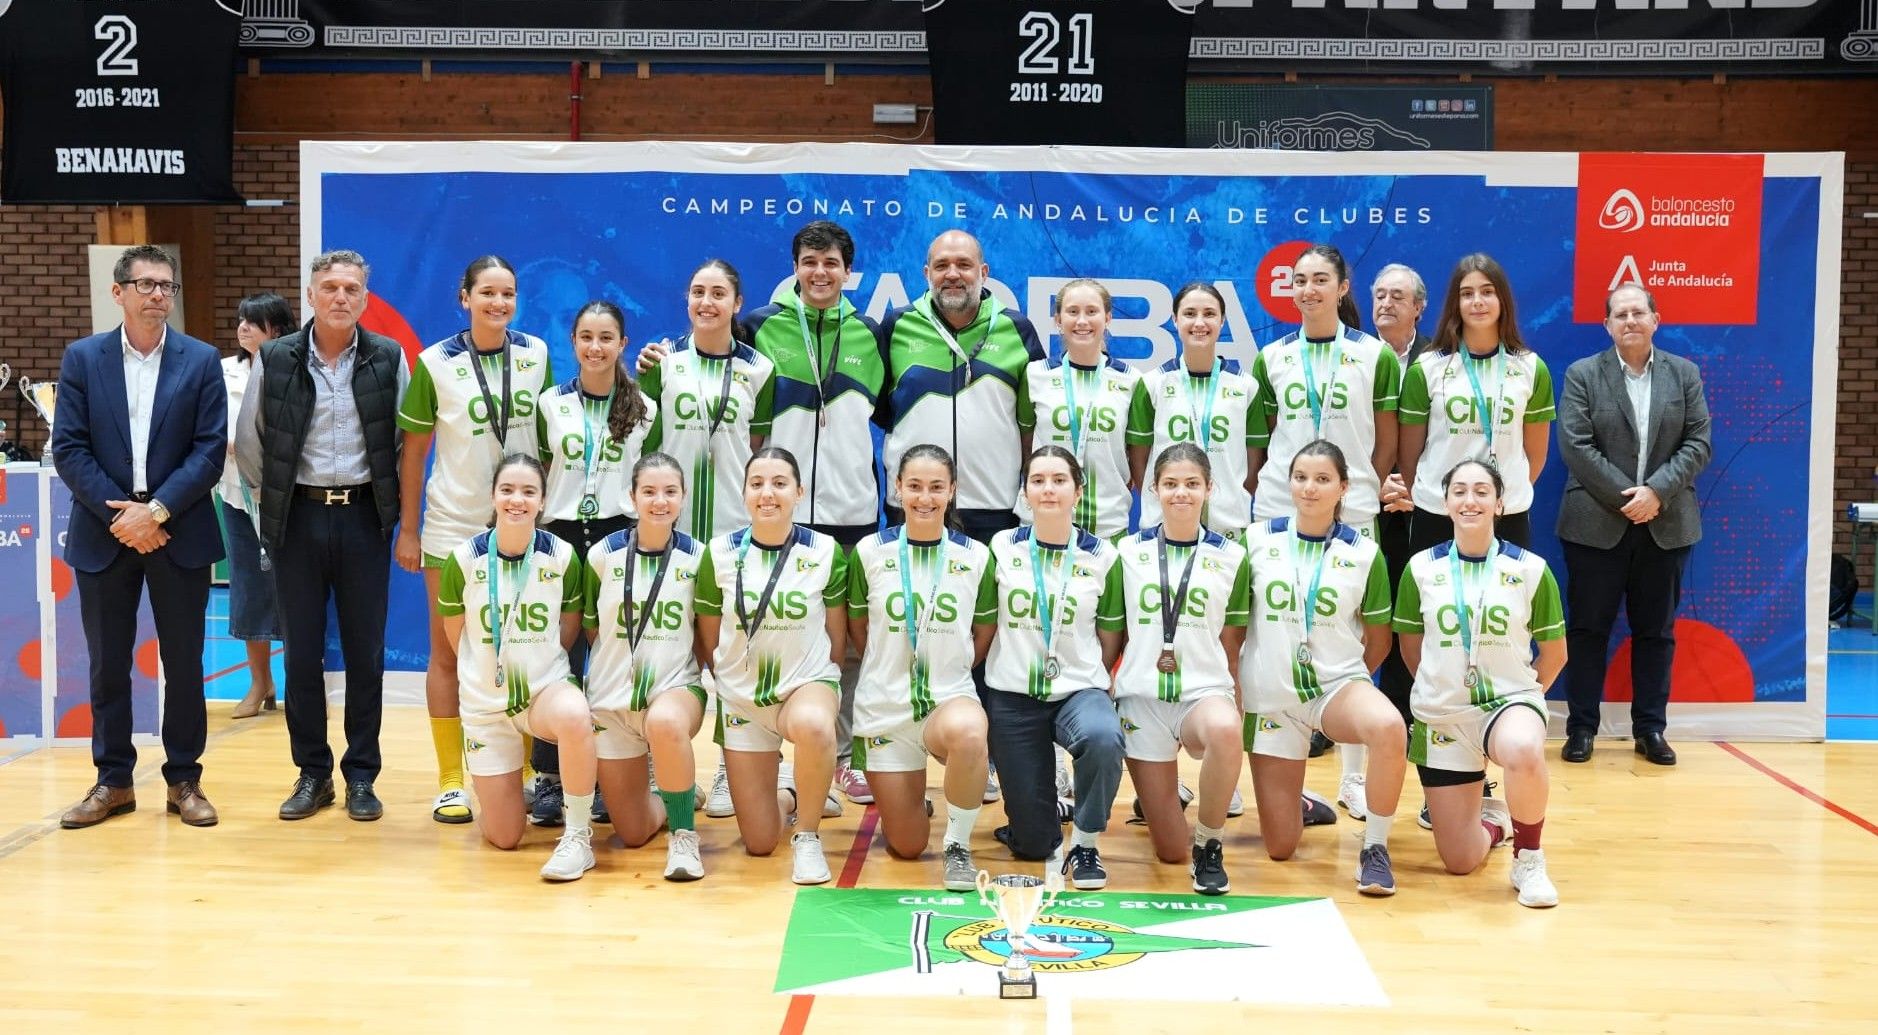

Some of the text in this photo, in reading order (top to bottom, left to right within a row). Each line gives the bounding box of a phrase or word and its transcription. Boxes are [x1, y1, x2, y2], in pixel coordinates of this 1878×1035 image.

[94, 15, 139, 76] 2
[1018, 11, 1095, 75] 21
[1216, 120, 1376, 149] Uniformes
[55, 147, 186, 175] BENAHAVIS
[662, 197, 1432, 224] CAMPEONATO DE ANDALUCIA DE CLUBES
[1651, 195, 1735, 213] baloncesto
[1648, 260, 1687, 272] Junta
[1648, 273, 1733, 287] de Andalucía
[561, 433, 624, 462] CS
[897, 896, 1228, 912] CLUB NTICO SEVILLA
[952, 916, 1111, 938] LUB UTICO
[1031, 960, 1111, 970] VILLA
